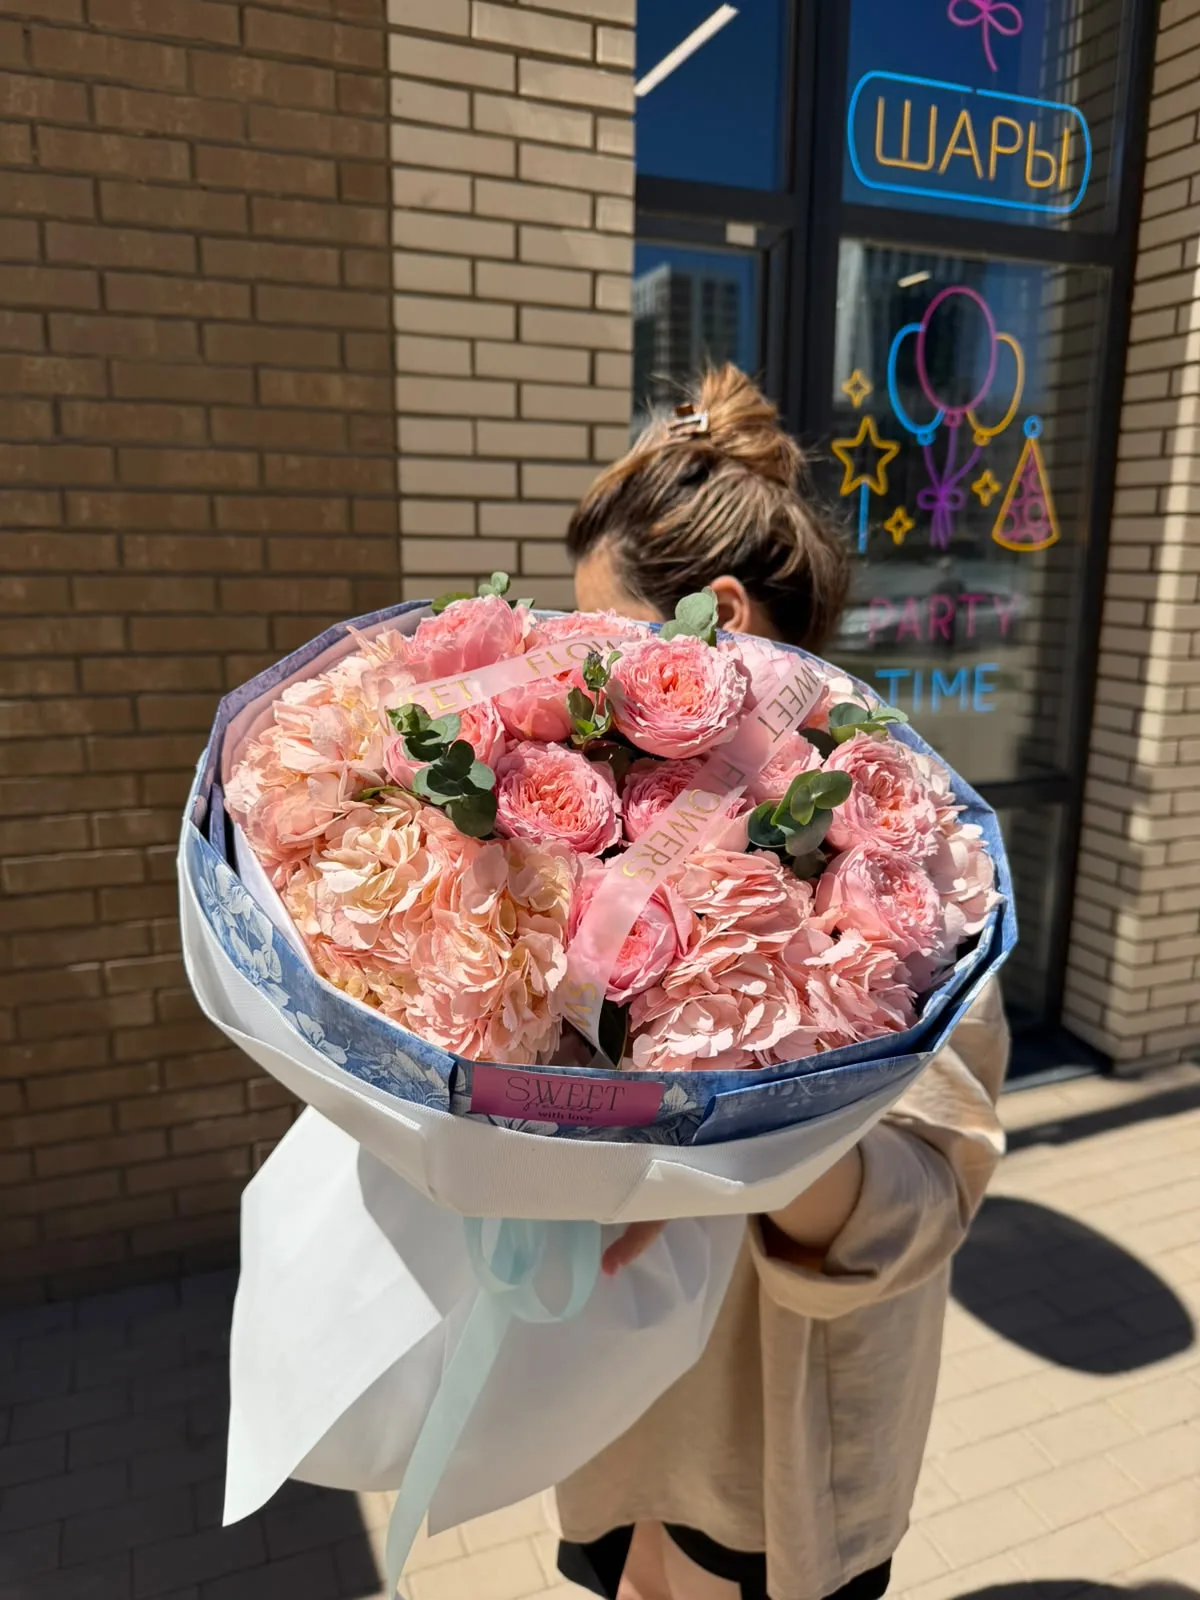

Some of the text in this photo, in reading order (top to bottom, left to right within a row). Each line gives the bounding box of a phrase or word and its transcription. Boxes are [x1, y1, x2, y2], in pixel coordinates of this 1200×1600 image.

[875, 96, 1070, 190] ШАРЫ
[867, 592, 1024, 642] PARTY
[758, 661, 820, 743] WEET
[875, 662, 999, 714] TIME
[505, 1076, 625, 1111] SWEET
[538, 1111, 593, 1121] with love
